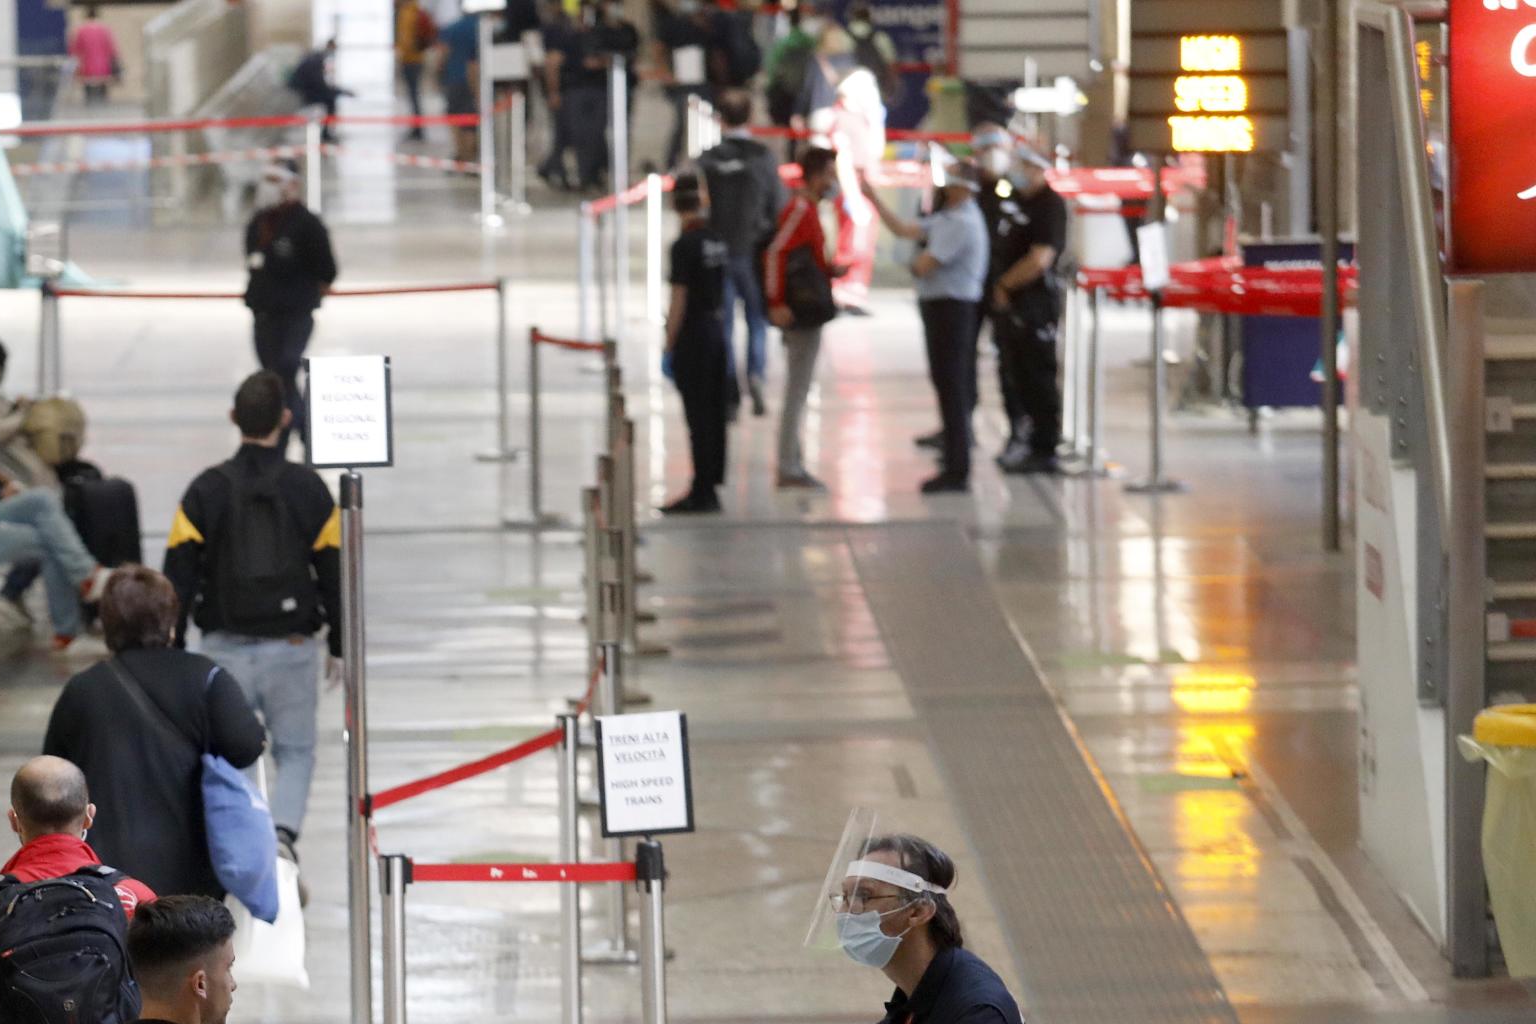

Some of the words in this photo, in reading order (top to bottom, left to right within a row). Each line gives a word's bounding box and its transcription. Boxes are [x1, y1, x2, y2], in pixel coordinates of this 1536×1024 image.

[609, 735, 640, 744] TRENI
[643, 732, 670, 742] ALTA
[611, 780, 638, 789] HIGH
[641, 776, 674, 787] SPEED
[624, 796, 663, 805] TRAINS
